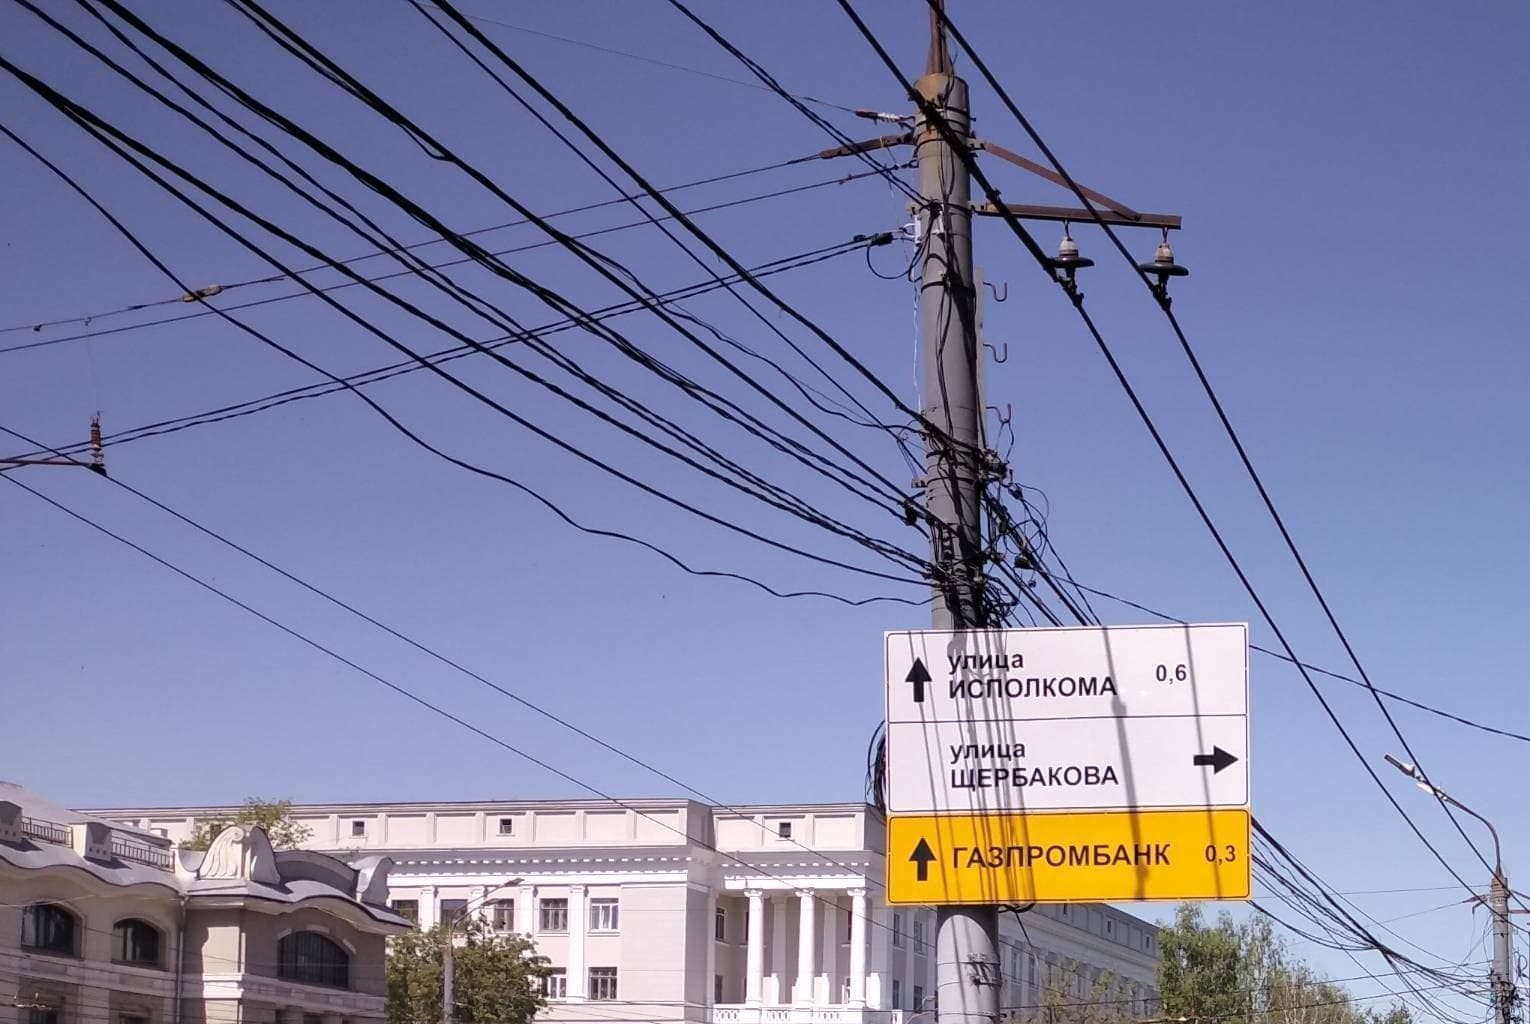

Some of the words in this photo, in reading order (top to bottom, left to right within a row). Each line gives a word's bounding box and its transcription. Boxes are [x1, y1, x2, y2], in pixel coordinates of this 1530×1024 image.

[949, 653, 1024, 674] улица
[1156, 664, 1187, 685] 0,6
[949, 676, 1117, 699] ИСПОЛКОМА
[950, 742, 1025, 764] улица
[950, 766, 1118, 791] ЩЕРБАКОВА
[953, 843, 1171, 869] ГАЗПРОМБАНК
[1205, 845, 1236, 865] 0,3
